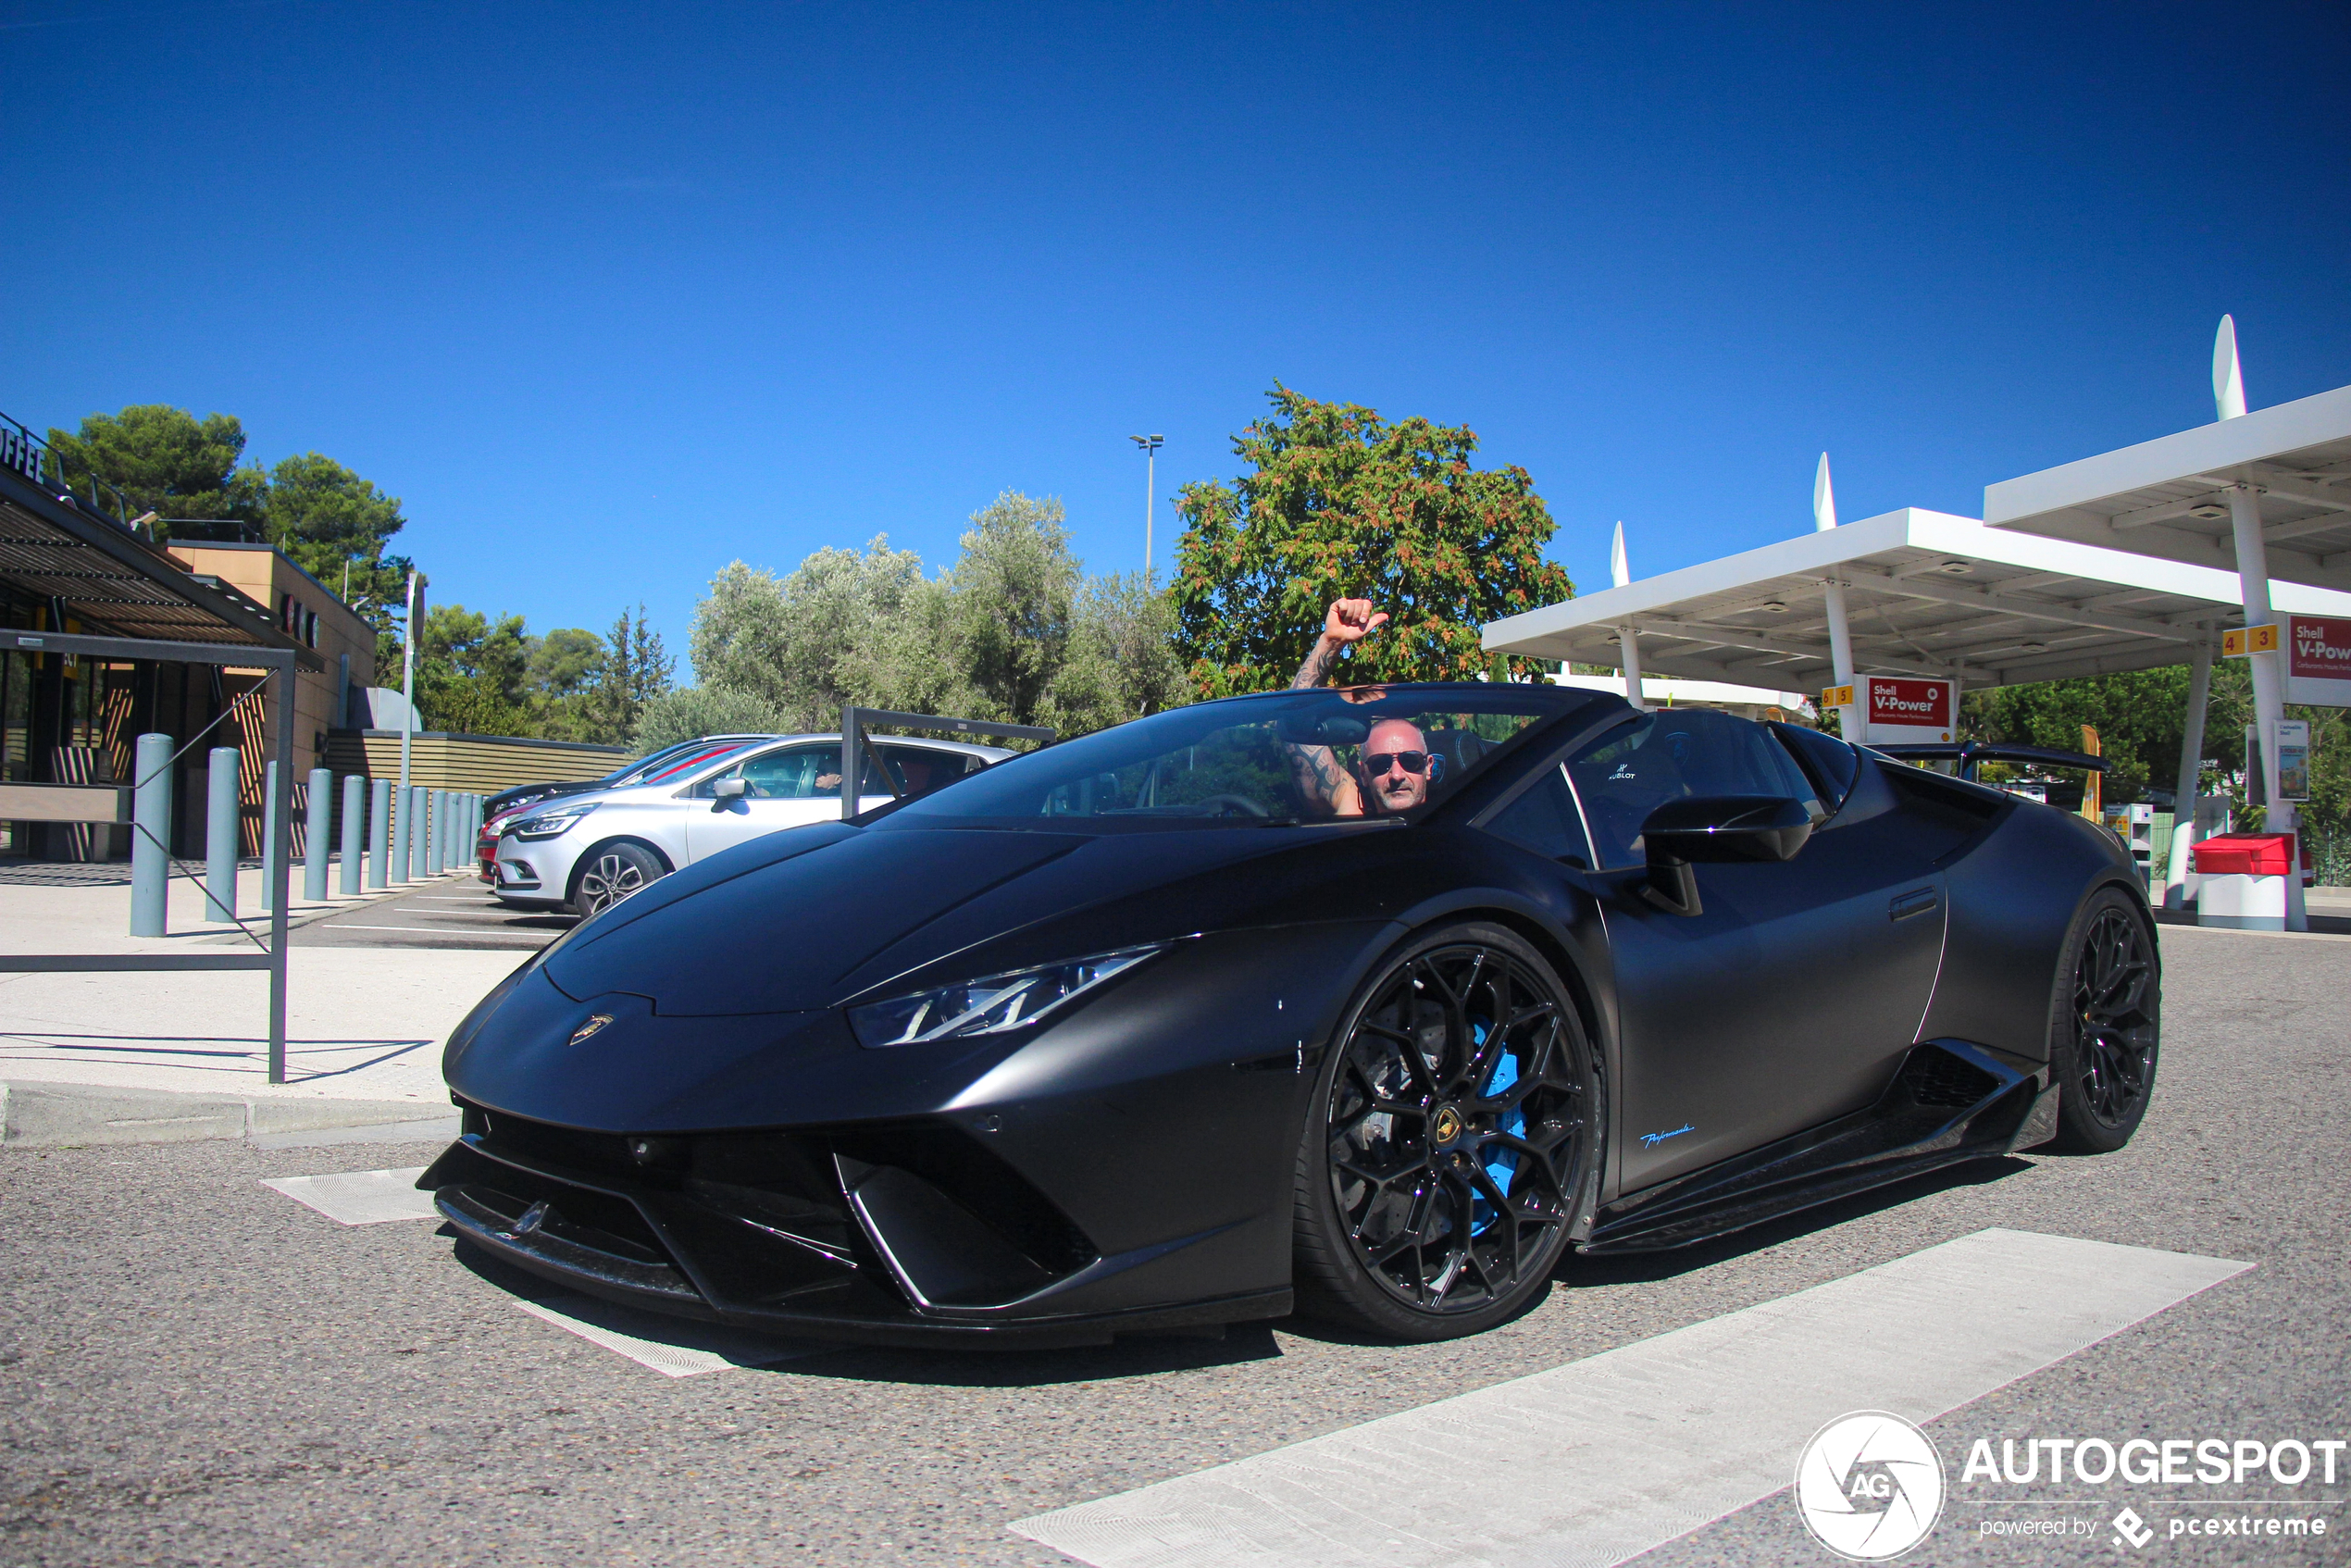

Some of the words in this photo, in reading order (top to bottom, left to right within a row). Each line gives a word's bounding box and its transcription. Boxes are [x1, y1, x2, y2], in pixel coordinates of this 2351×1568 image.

[2296, 625, 2324, 640] Shell
[2225, 637, 2235, 651] 4
[2259, 630, 2270, 646] 3
[1822, 692, 1829, 703] 6
[1840, 690, 1847, 702] 5
[1874, 685, 1897, 696] Shell
[1874, 696, 1934, 712] V-Power
